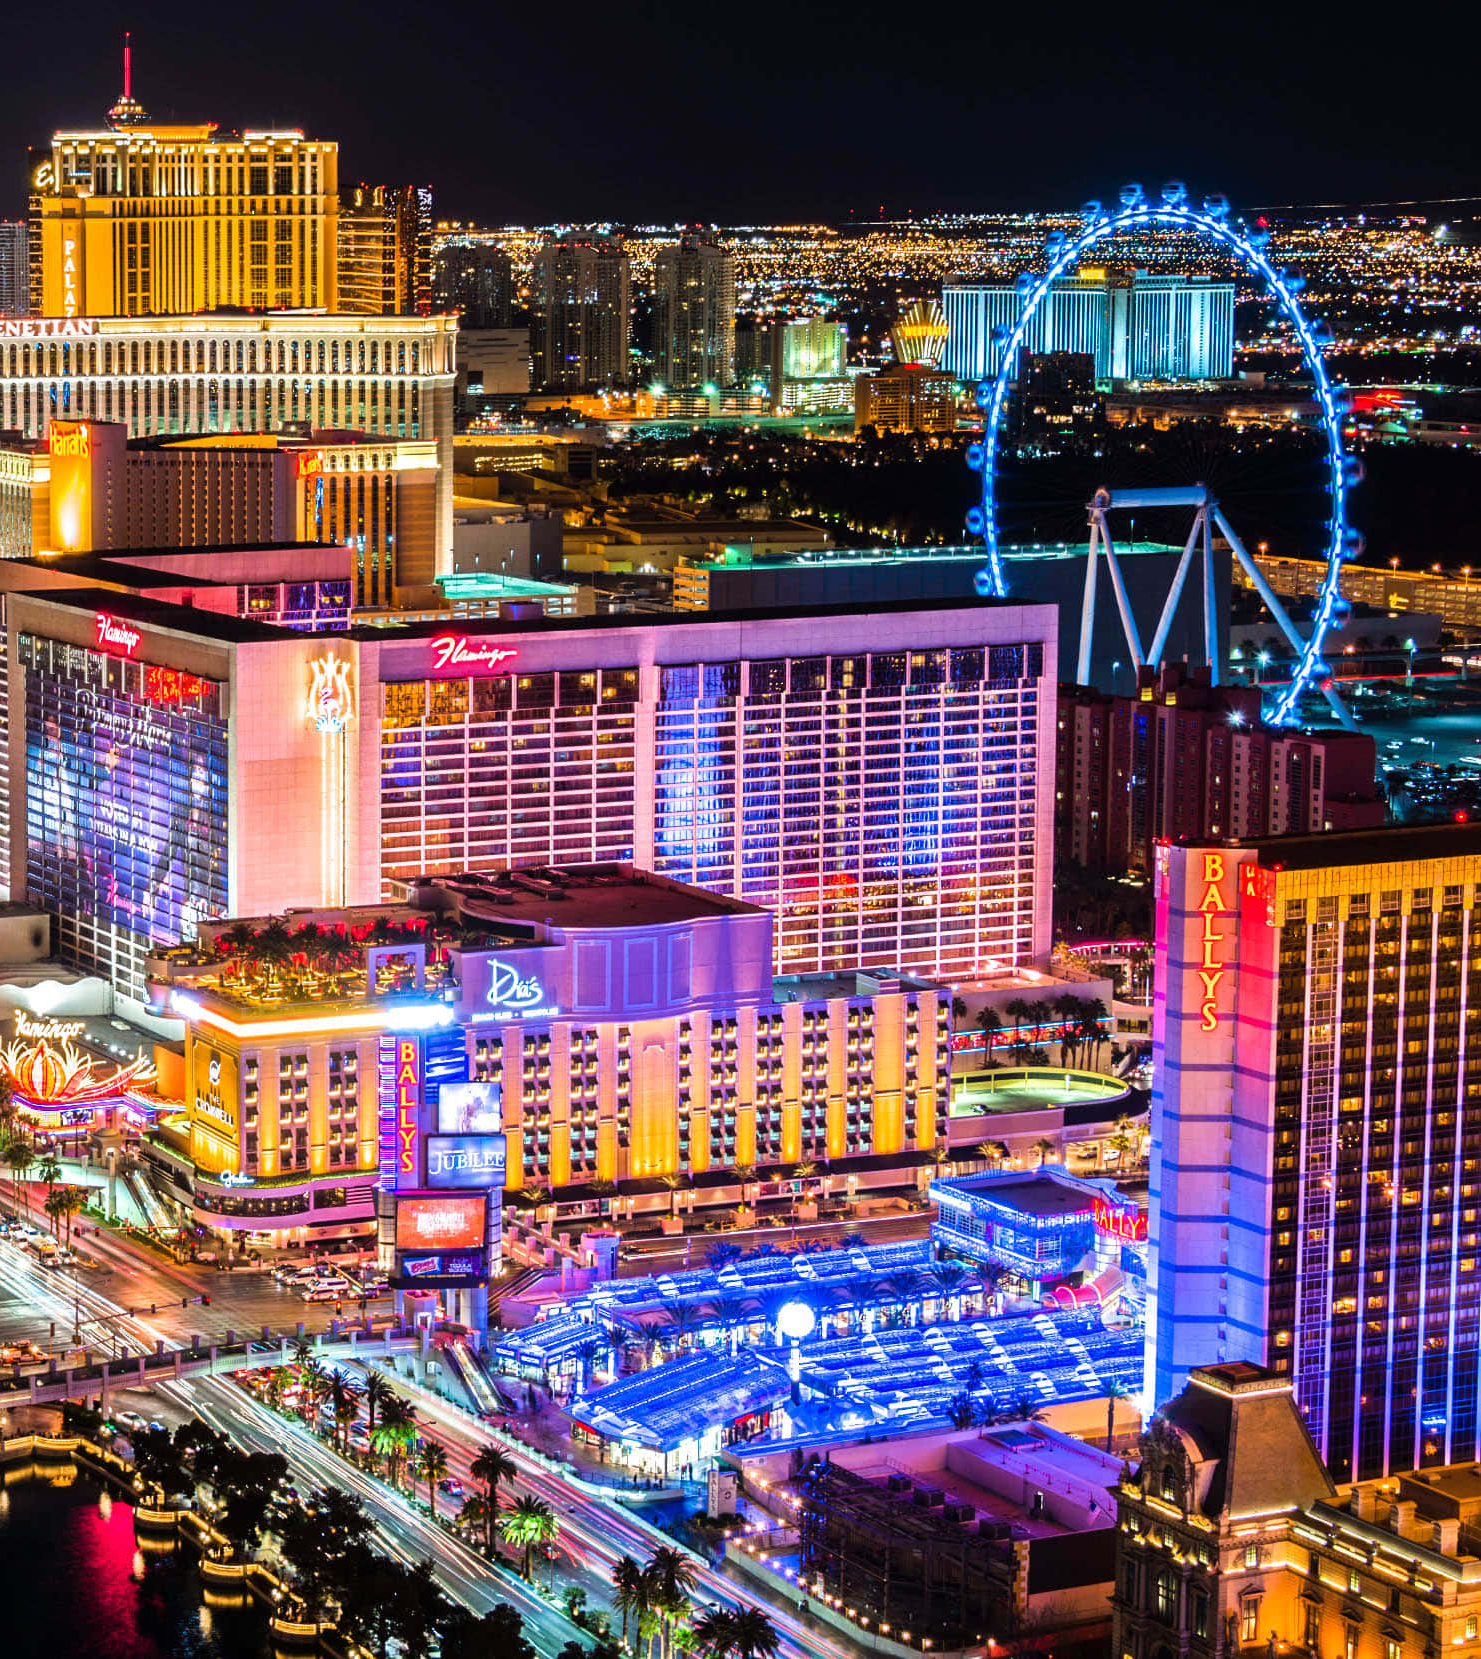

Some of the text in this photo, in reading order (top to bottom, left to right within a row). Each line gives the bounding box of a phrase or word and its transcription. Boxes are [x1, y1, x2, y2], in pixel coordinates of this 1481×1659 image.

[96, 614, 140, 654] Flamingo
[431, 637, 517, 668] Flamingo
[1199, 854, 1226, 1031] BALLYS
[15, 1009, 85, 1042] Flamingo
[196, 1096, 234, 1128] CROMWELL
[210, 1092, 221, 1105] THE
[399, 1041, 416, 1172] BALLYS
[429, 1151, 505, 1175] JUBILEE
